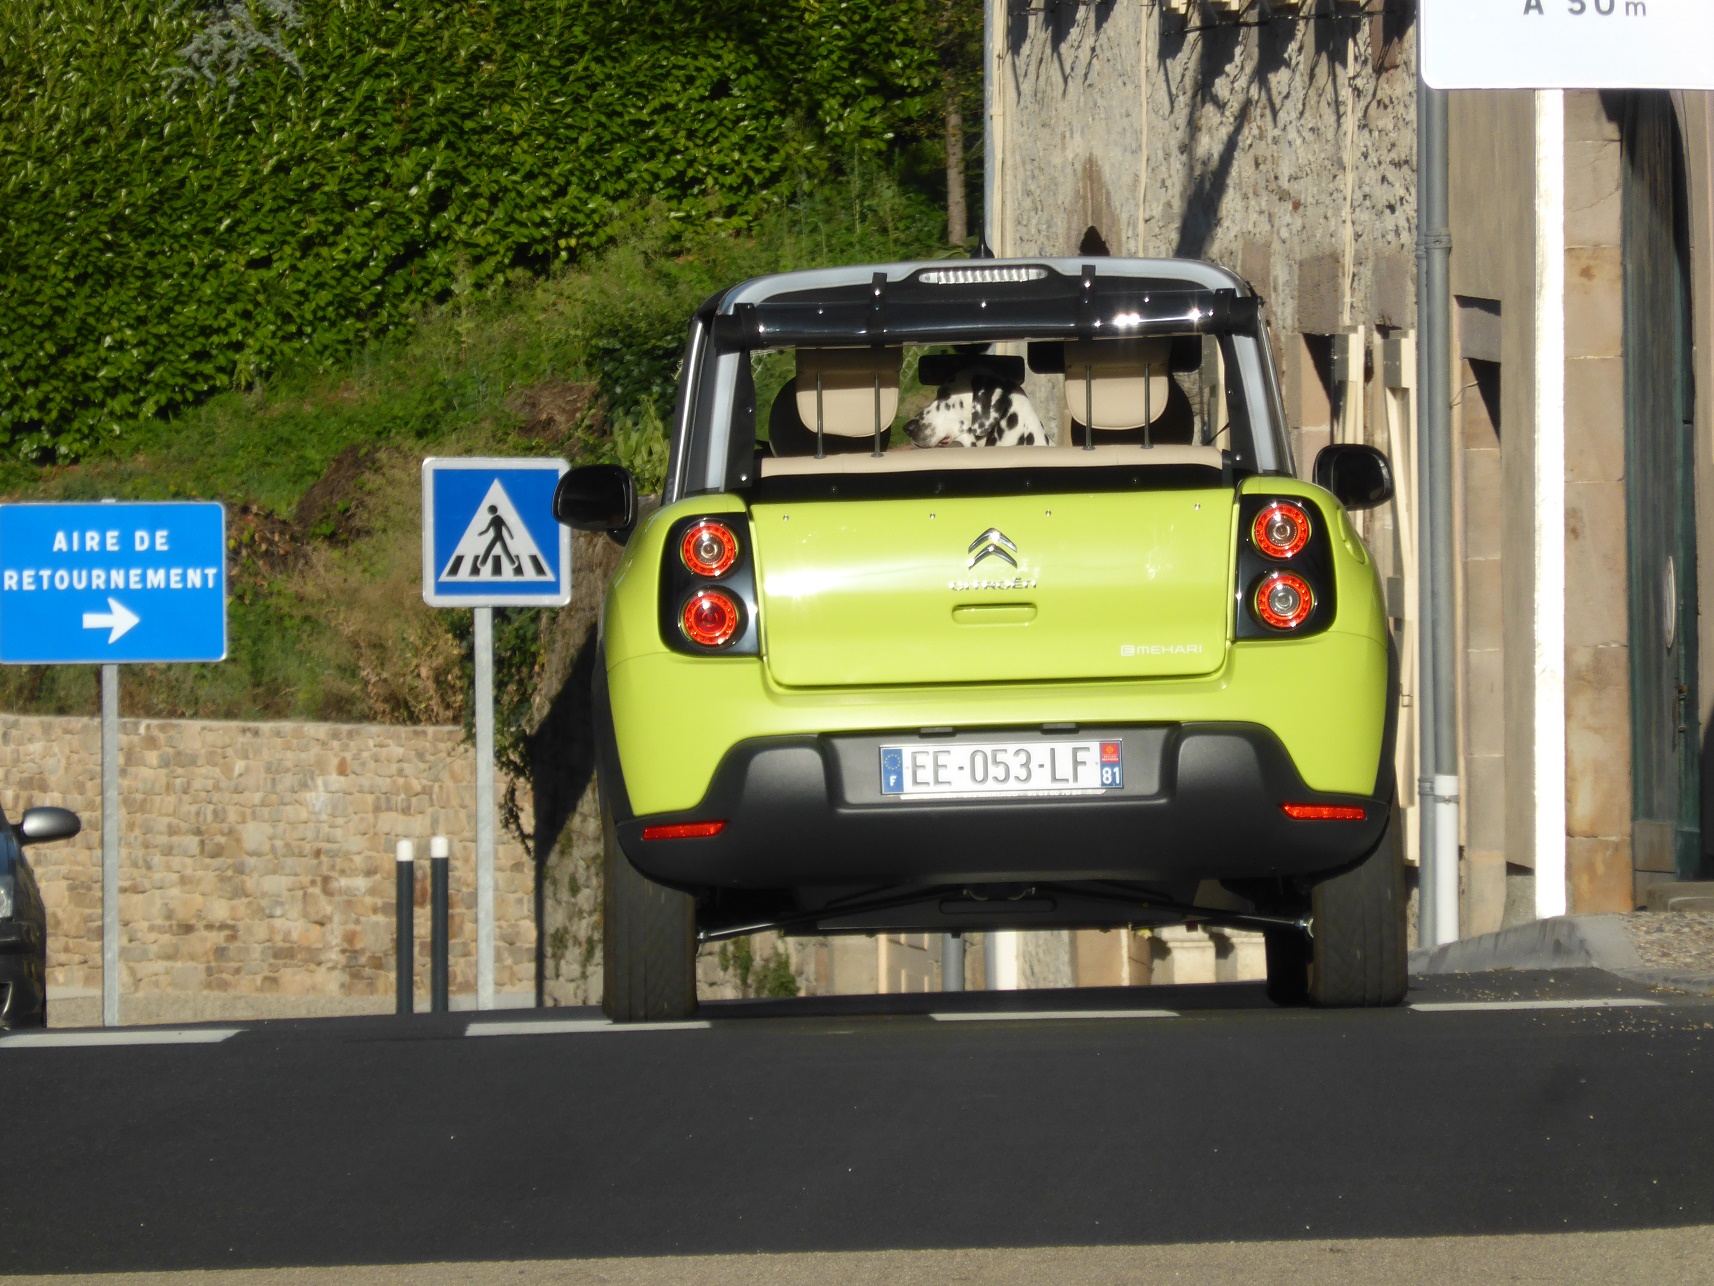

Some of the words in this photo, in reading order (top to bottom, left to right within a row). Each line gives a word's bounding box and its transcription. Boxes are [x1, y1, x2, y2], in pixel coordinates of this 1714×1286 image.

[52, 531, 120, 552] AIRE
[134, 530, 169, 551] DE
[3, 567, 218, 590] RETOURNEMENT
[1102, 766, 1120, 785] 81
